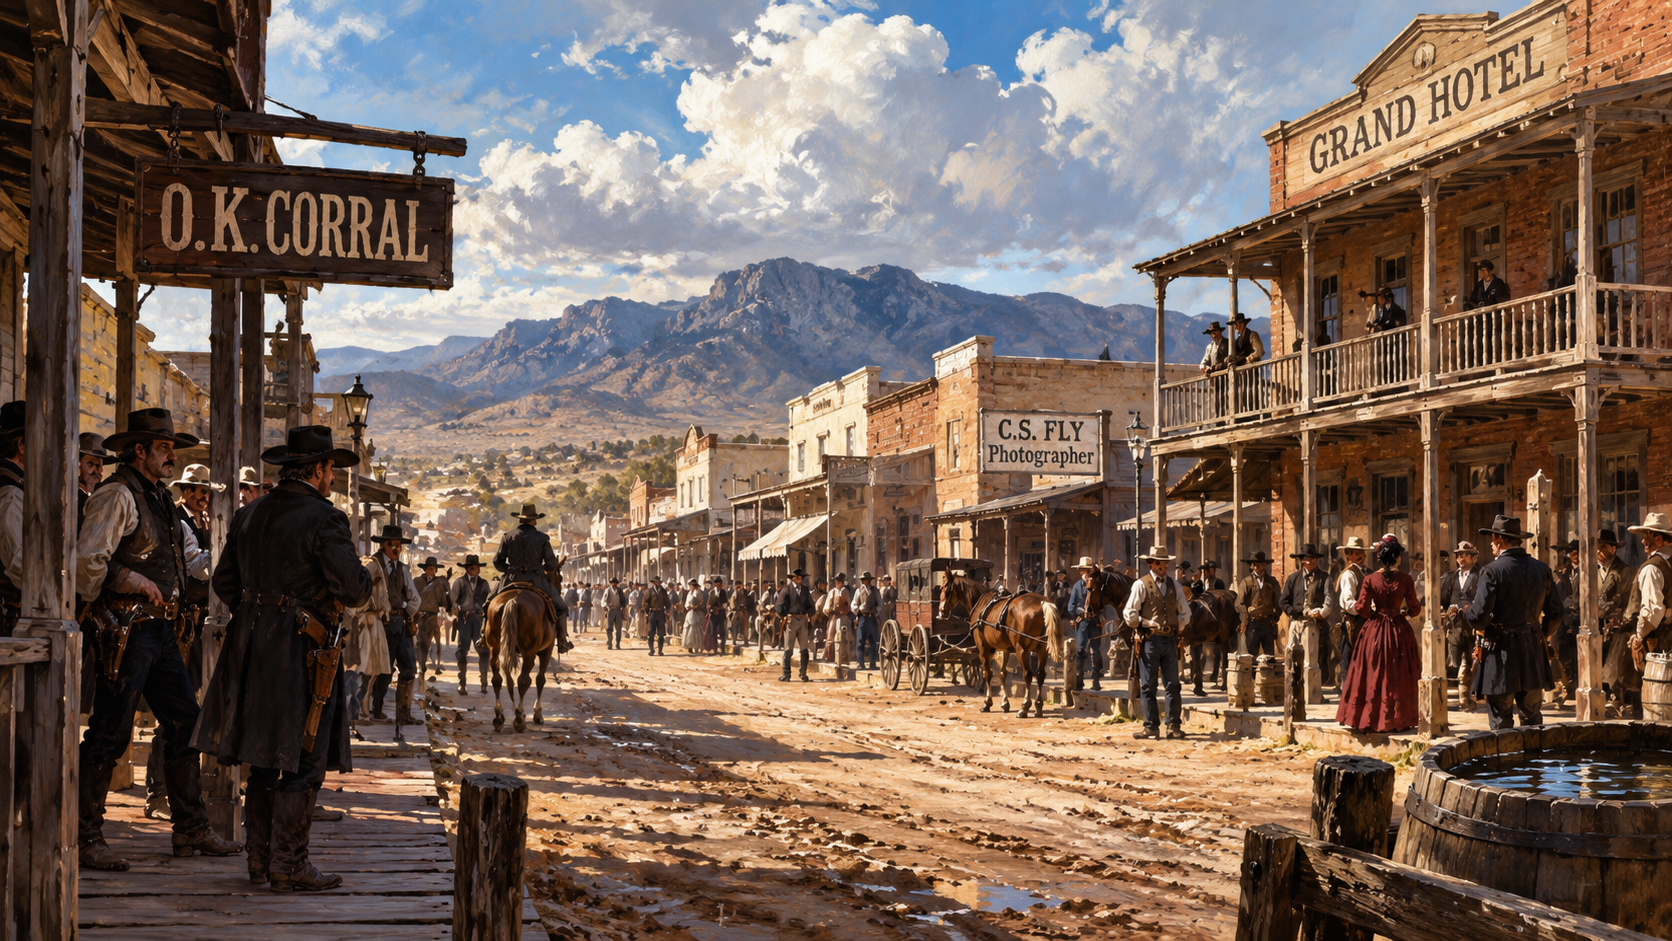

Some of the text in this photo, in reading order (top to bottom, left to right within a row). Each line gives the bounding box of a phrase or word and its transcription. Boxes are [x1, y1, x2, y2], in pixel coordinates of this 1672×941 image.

[1309, 36, 1545, 174] GRAND HOTEL
[265, 189, 429, 263] CORRAL
[998, 418, 1085, 442] C.S. FLY
[987, 444, 1095, 469] Photographer
